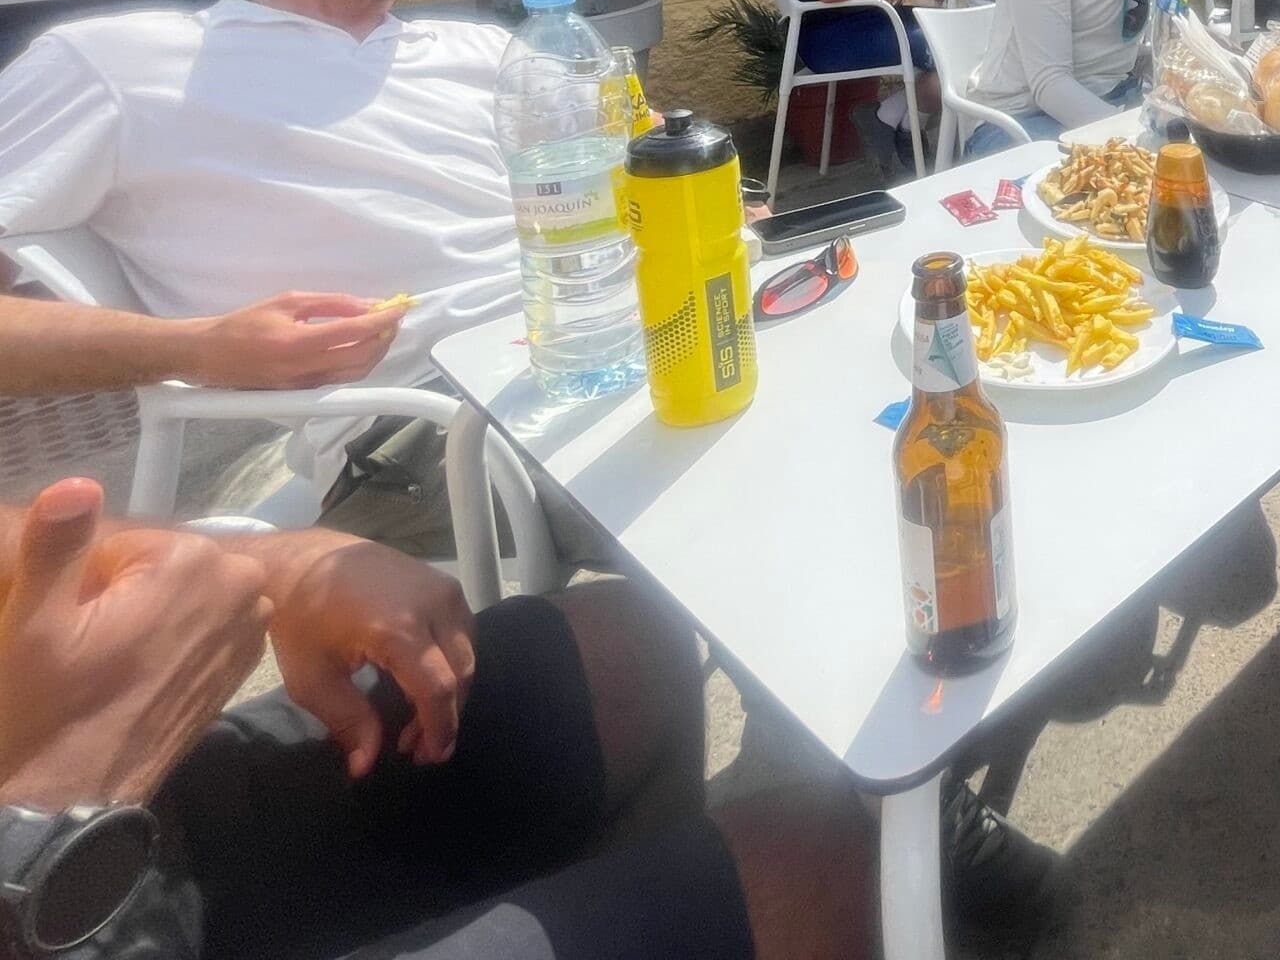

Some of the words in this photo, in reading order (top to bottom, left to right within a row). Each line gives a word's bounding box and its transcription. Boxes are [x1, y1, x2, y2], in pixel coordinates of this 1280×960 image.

[714, 294, 725, 338] SCIENCE
[720, 288, 730, 322] SPORT
[723, 324, 732, 336] IN
